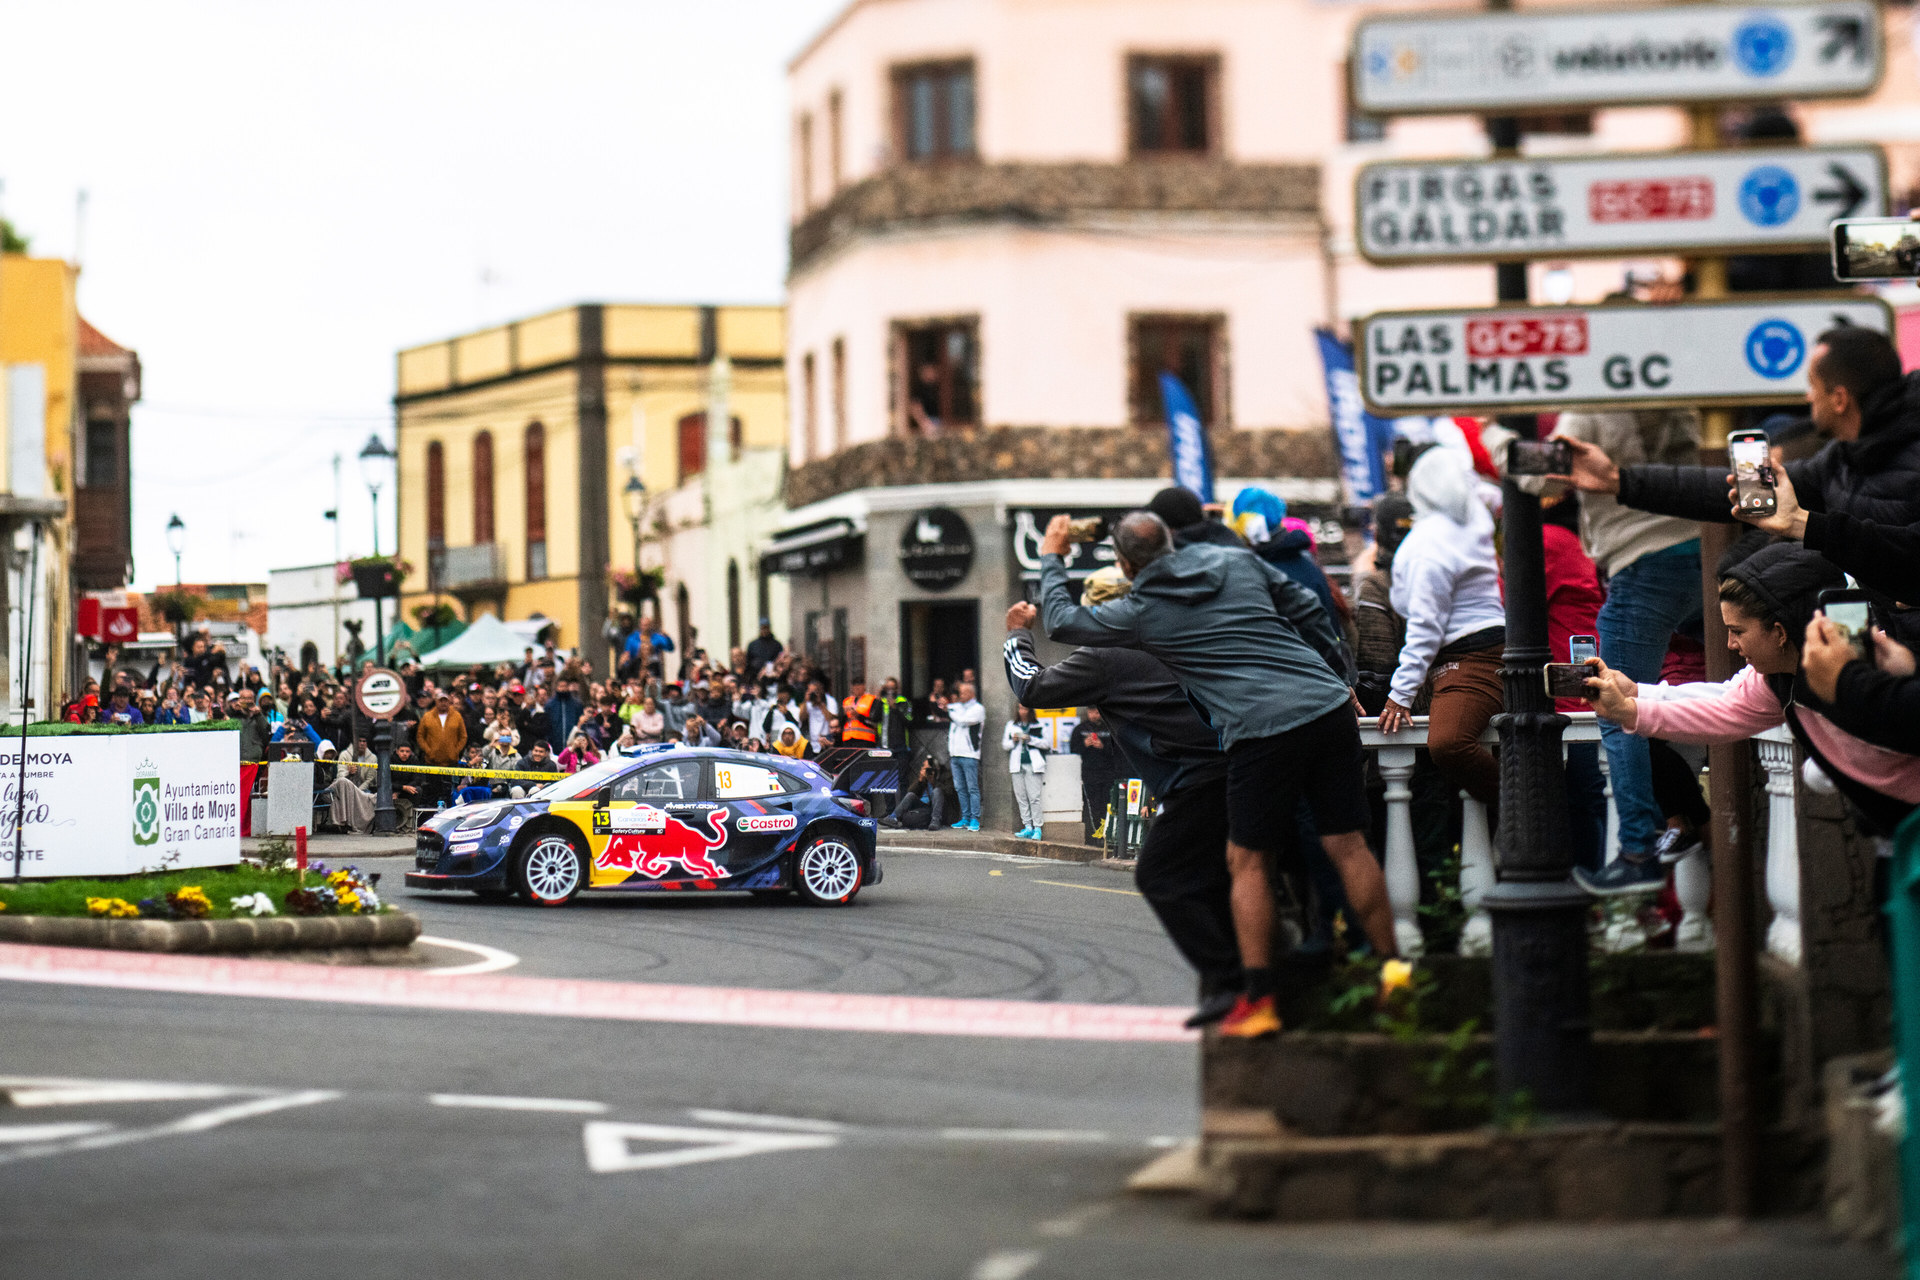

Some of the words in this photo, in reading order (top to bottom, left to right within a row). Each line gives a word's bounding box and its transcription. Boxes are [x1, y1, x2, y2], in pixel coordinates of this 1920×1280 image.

[1375, 325, 1453, 356] LAS
[1472, 322, 1584, 353] GC-75
[1375, 357, 1571, 396] PALMAS
[1602, 354, 1672, 390] GC
[0, 754, 21, 765] DE
[27, 753, 72, 765] MOYA
[18, 771, 54, 779] UMBRE
[457, 769, 487, 777] PUBLICO
[493, 771, 512, 779] ZONA
[717, 771, 732, 789] 13
[165, 781, 236, 802] Ayuntamiento
[164, 802, 188, 822] Villa
[192, 801, 205, 820] de
[208, 800, 236, 822] Moya
[593, 812, 610, 826] 13
[164, 826, 190, 842] Gran
[194, 822, 236, 841] Canaria
[750, 817, 794, 831] Castrol
